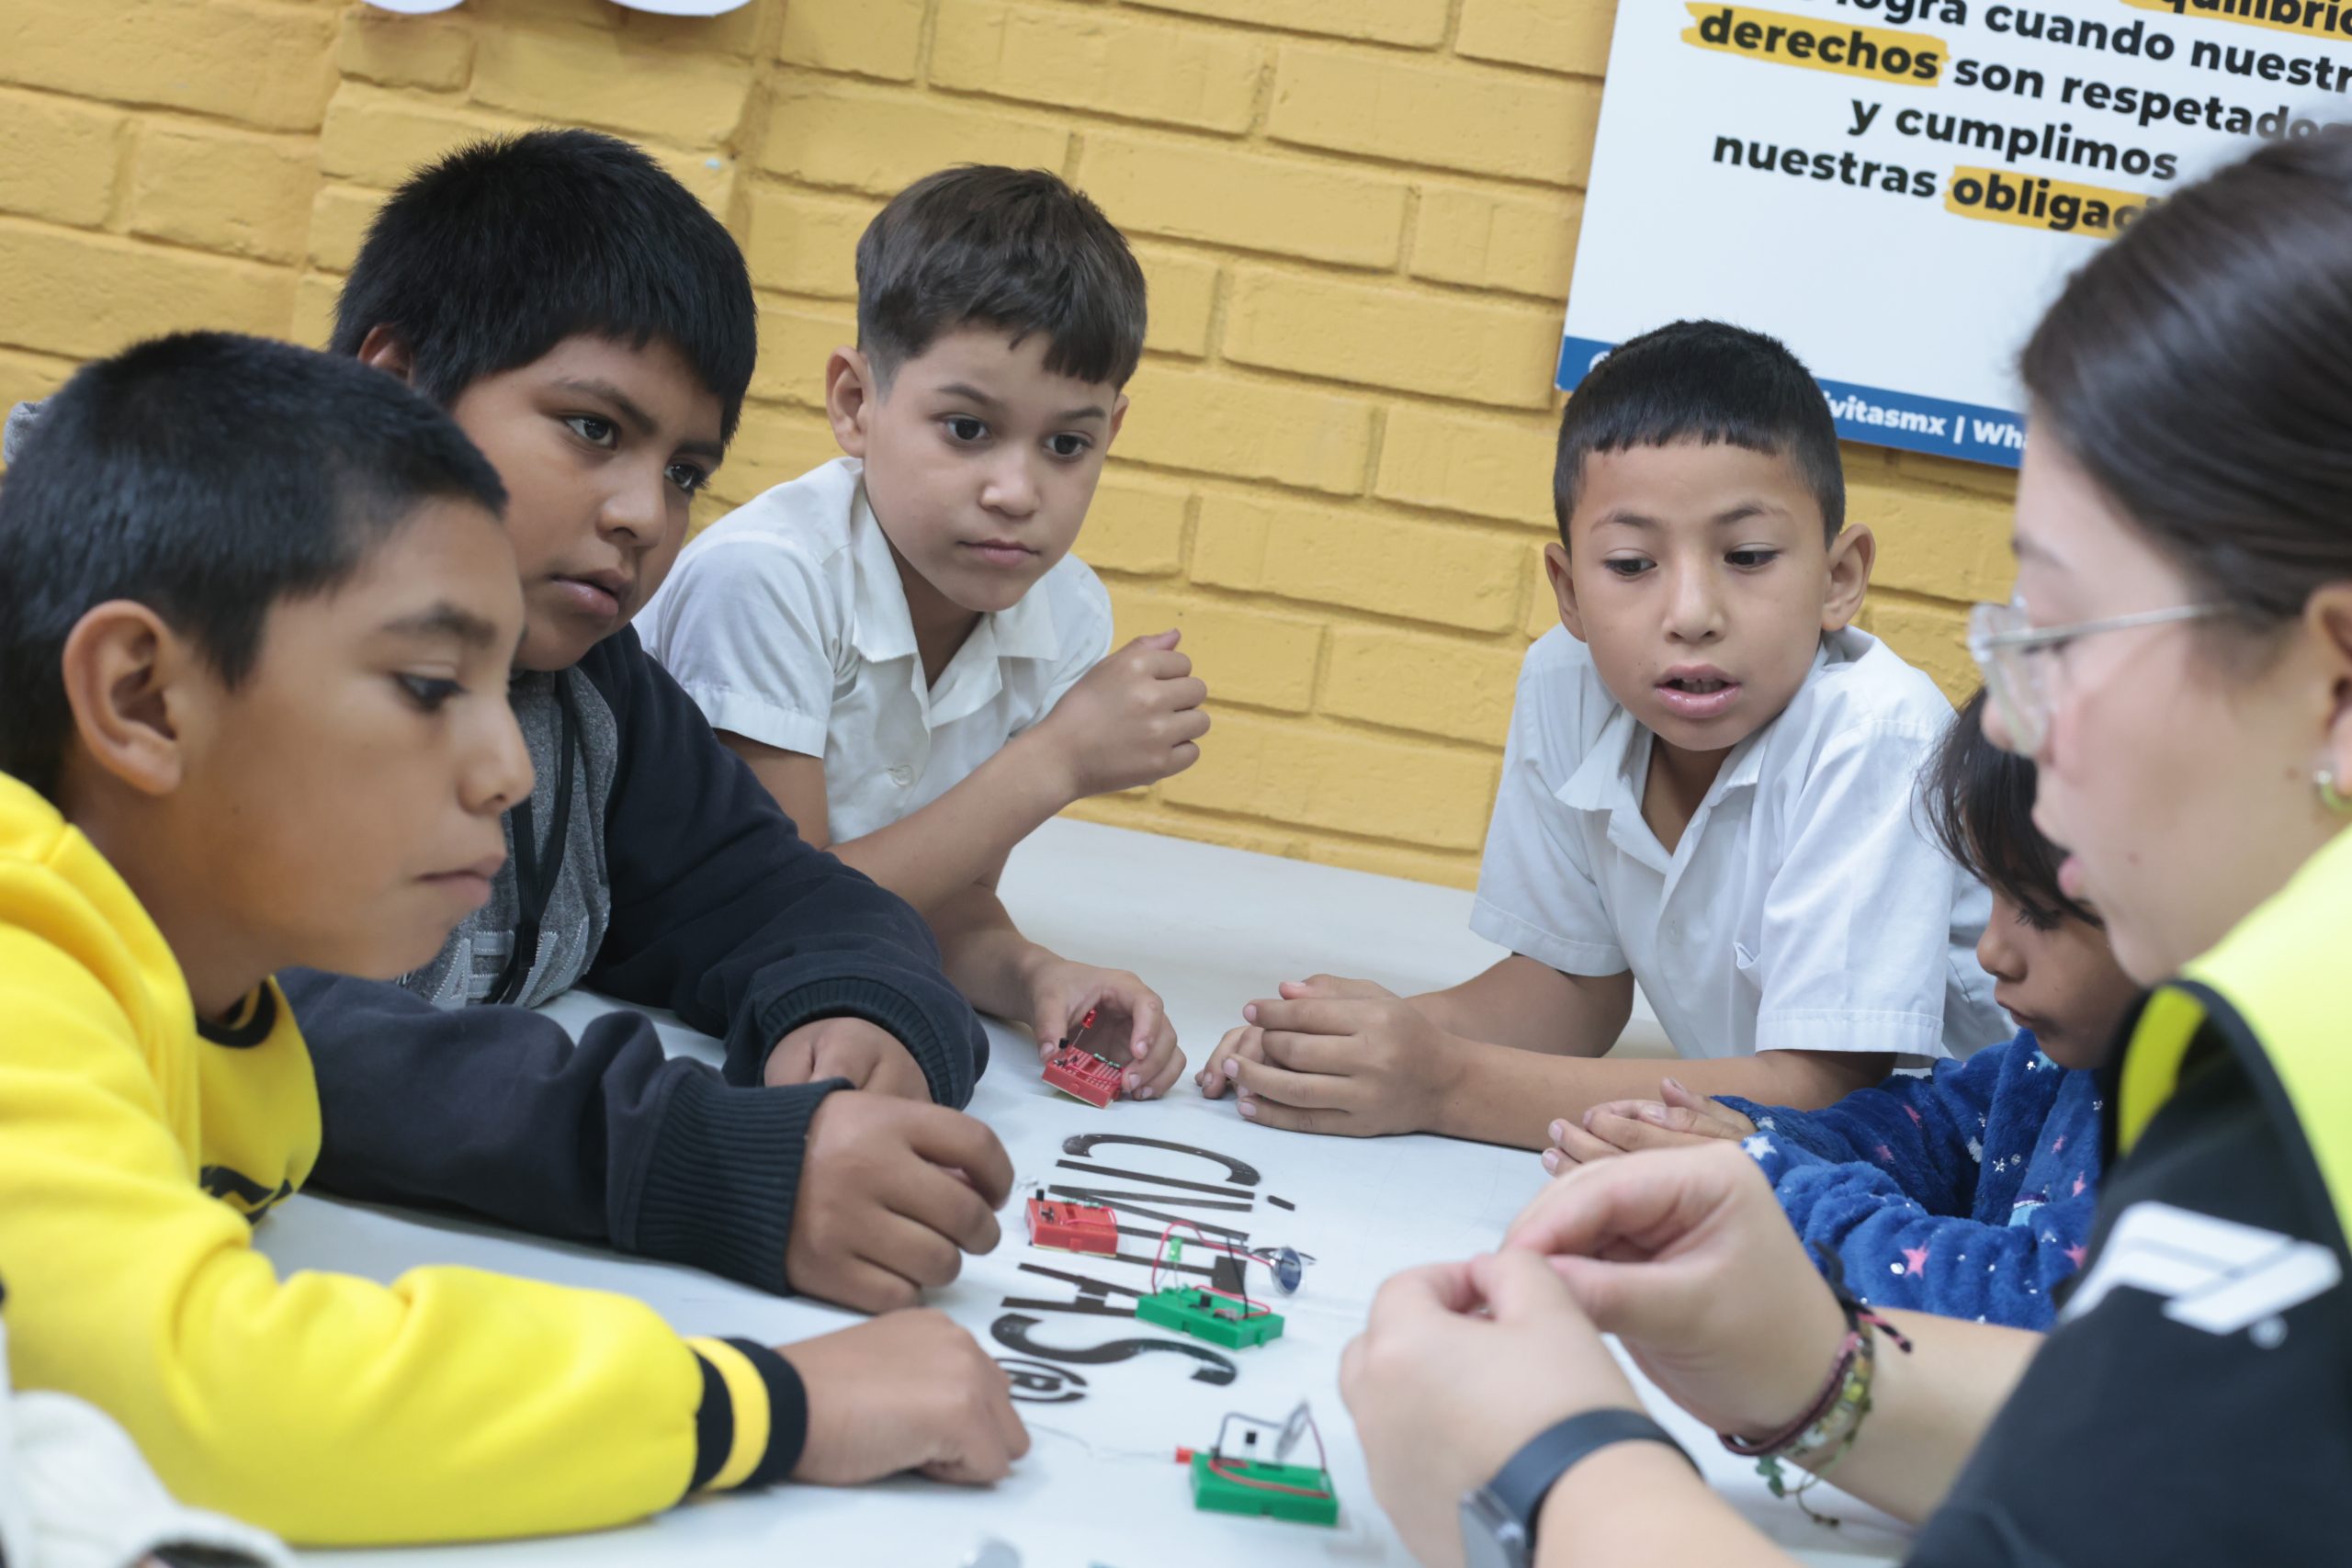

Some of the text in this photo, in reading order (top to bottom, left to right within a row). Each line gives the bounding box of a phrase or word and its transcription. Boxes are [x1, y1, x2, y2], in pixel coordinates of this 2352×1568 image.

[1700, 8, 1939, 80] derechos
[1953, 58, 2044, 98] son
[1837, 0, 1968, 26] gra
[1984, 5, 2175, 62] cuando
[1848, 98, 2178, 181] y cumplimos
[1713, 135, 2161, 231] nuestras obligac
